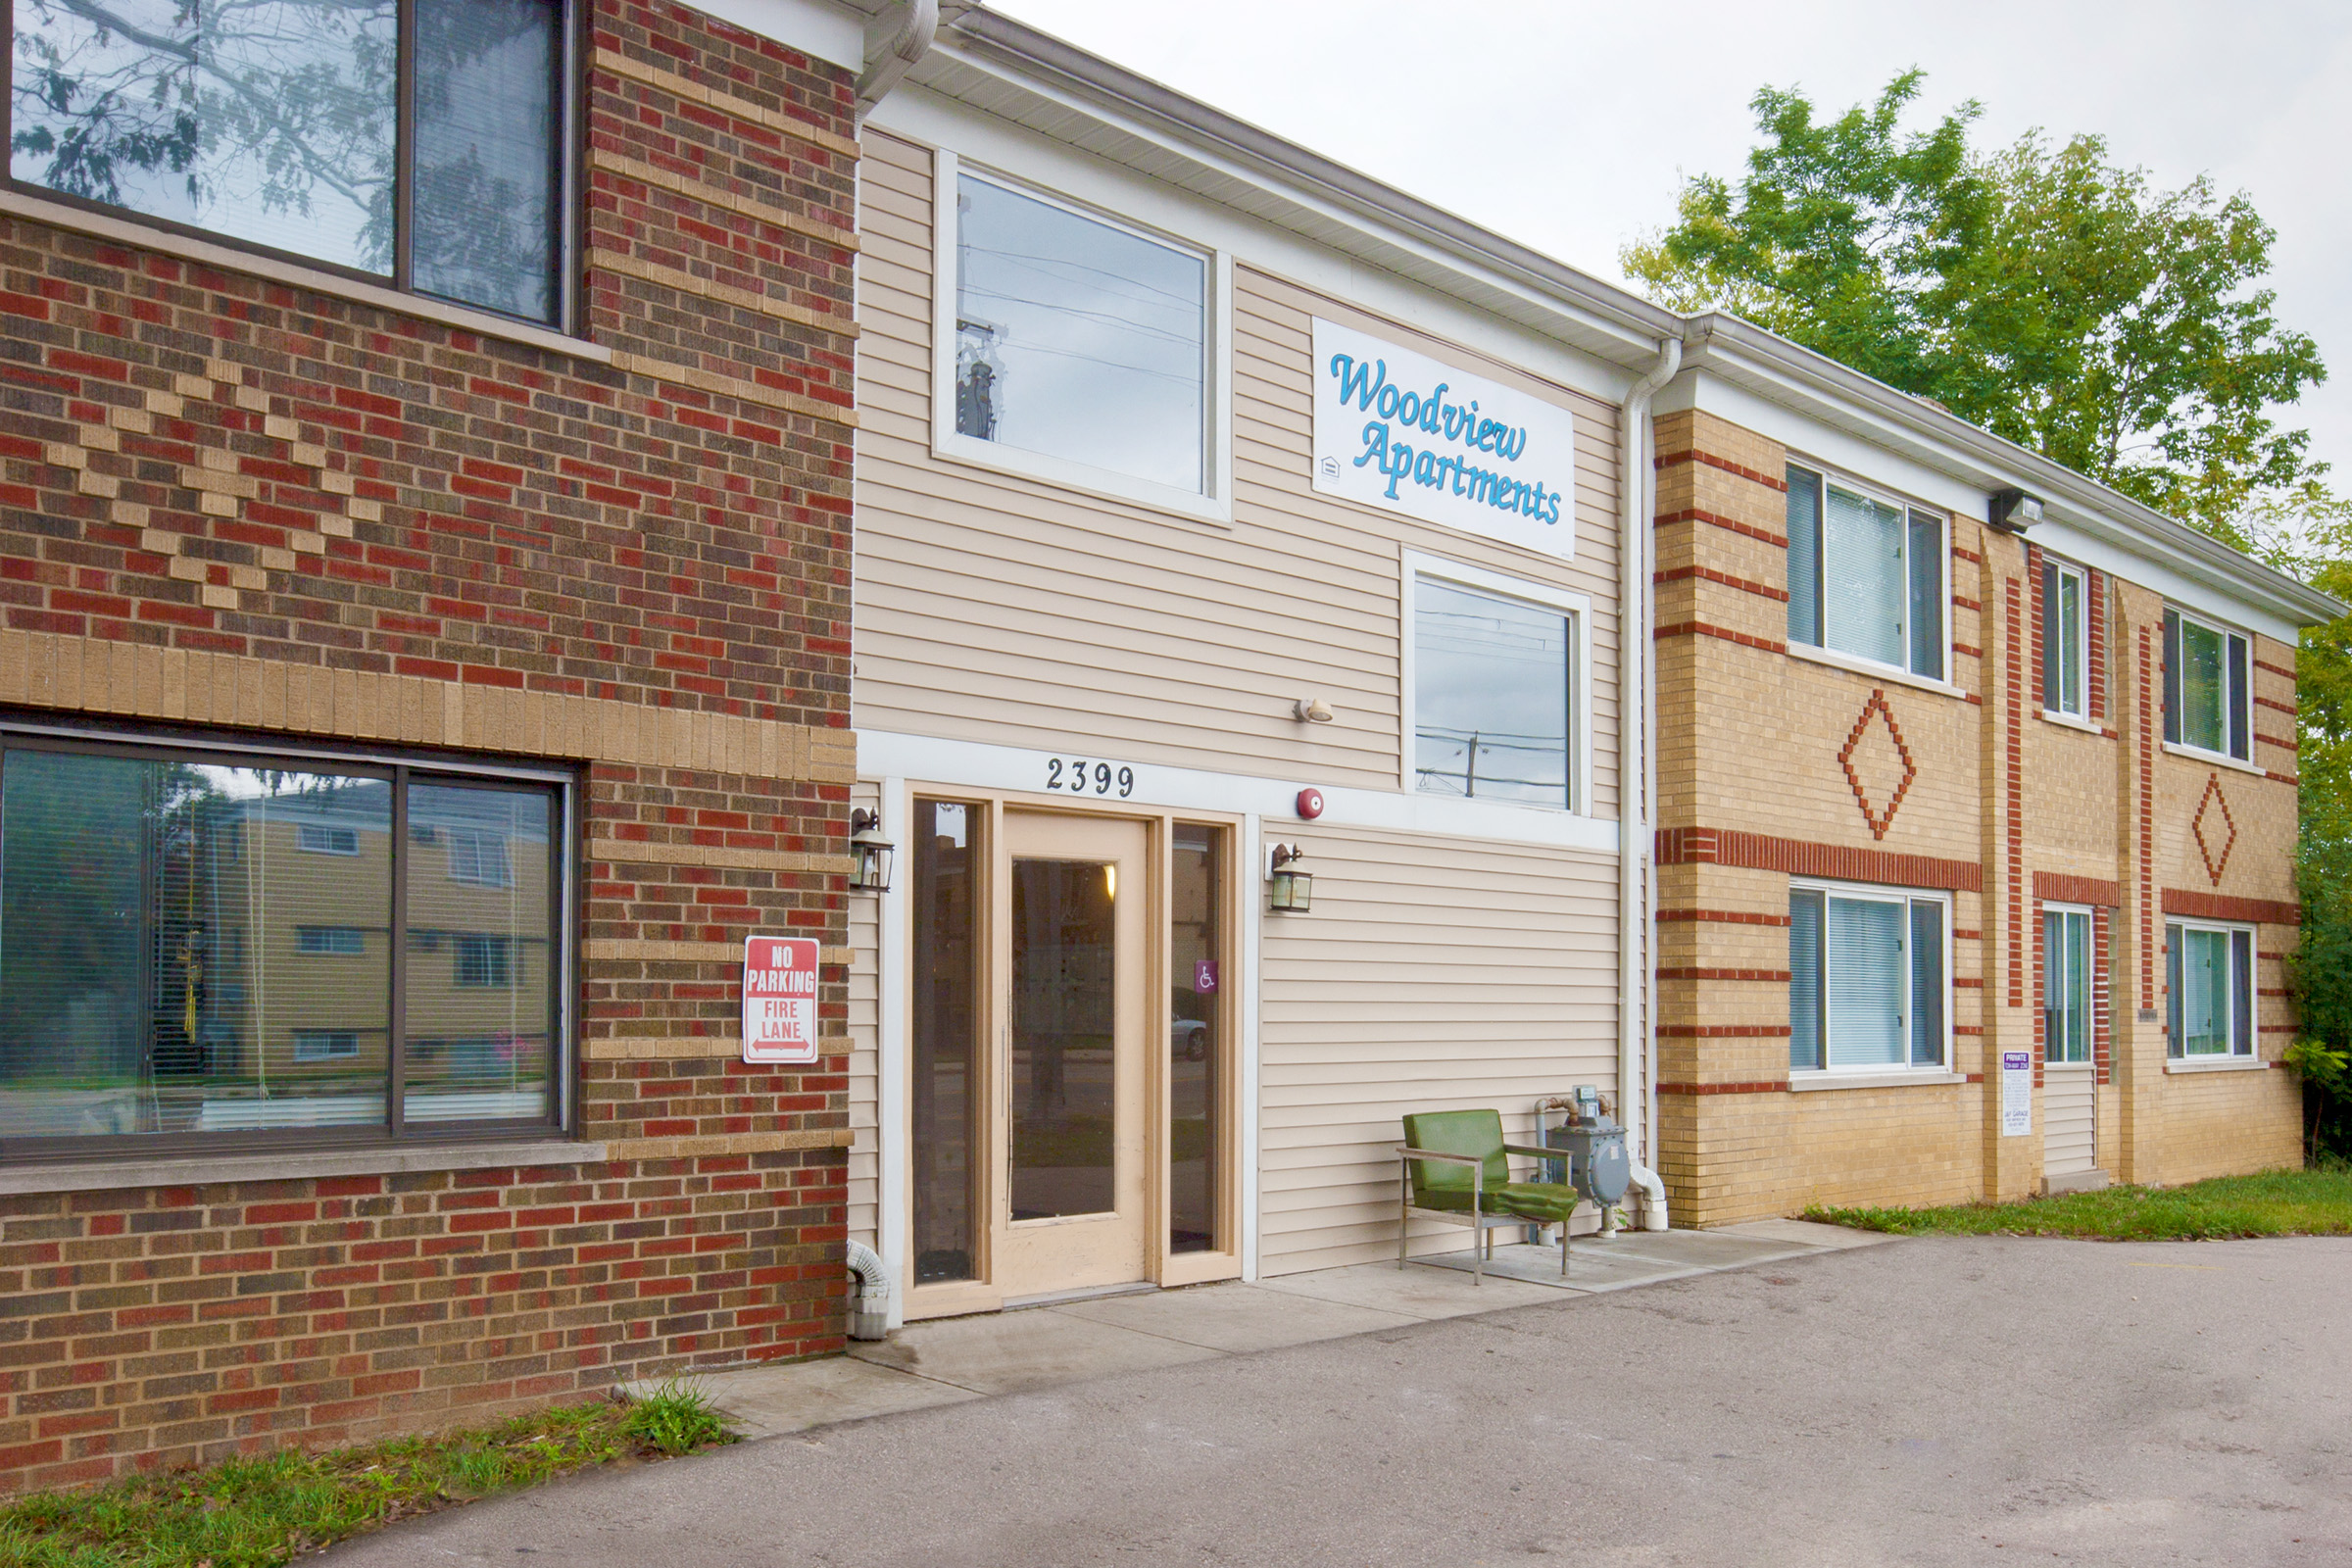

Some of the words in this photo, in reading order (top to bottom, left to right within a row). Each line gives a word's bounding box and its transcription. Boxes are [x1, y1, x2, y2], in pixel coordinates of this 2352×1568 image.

[1330, 354, 1526, 461] Woodview
[1353, 420, 1561, 525] Apartments
[1047, 758, 1134, 798] 2399
[771, 946, 793, 968] NO
[748, 969, 814, 993] PARKING
[764, 1001, 798, 1018] FIRE
[761, 1021, 801, 1039] LANE
